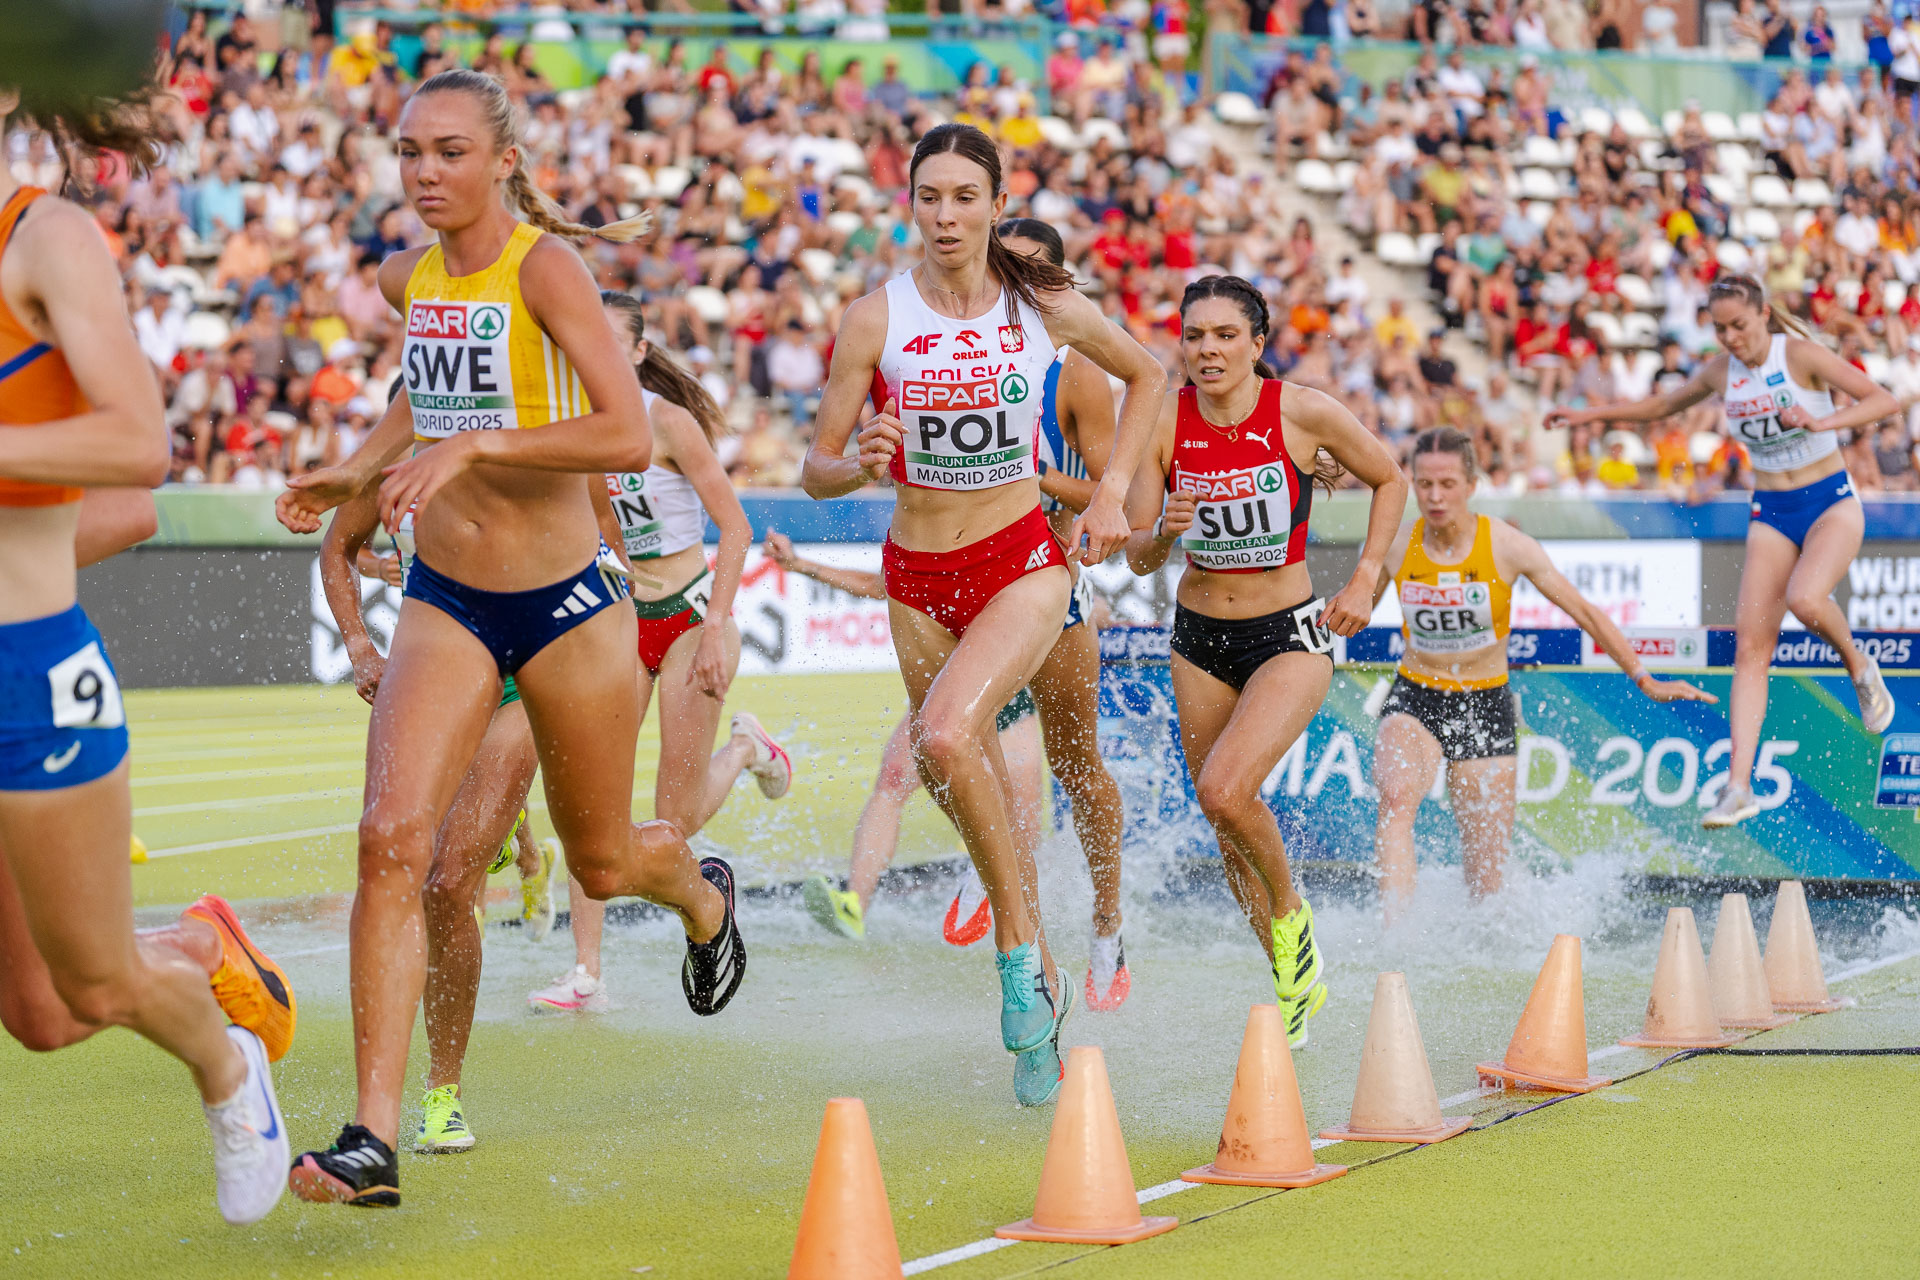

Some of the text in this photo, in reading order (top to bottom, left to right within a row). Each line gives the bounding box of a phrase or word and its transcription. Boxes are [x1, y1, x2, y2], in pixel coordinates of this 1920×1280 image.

[409, 308, 465, 335] SPAR
[952, 349, 988, 361] ORLEN
[408, 343, 498, 392] SWE
[417, 396, 436, 408] RUN
[905, 382, 997, 407] SPAR
[456, 414, 503, 432] 2025
[918, 410, 1020, 454] POL
[1192, 440, 1209, 449] UBS
[931, 456, 935, 465] I
[936, 456, 963, 467] RUN
[917, 461, 1024, 485] MADRID 2025
[1180, 475, 1254, 500] SPAR
[1198, 499, 1271, 540] SUI
[632, 533, 662, 551] 2025
[1204, 542, 1208, 550] I
[1209, 541, 1232, 551] RUN
[1192, 552, 1251, 566] MADRID
[1404, 586, 1463, 605] SPAR
[1415, 609, 1480, 631] GER
[74, 669, 103, 722] 9
[1591, 735, 1800, 808] 2025
